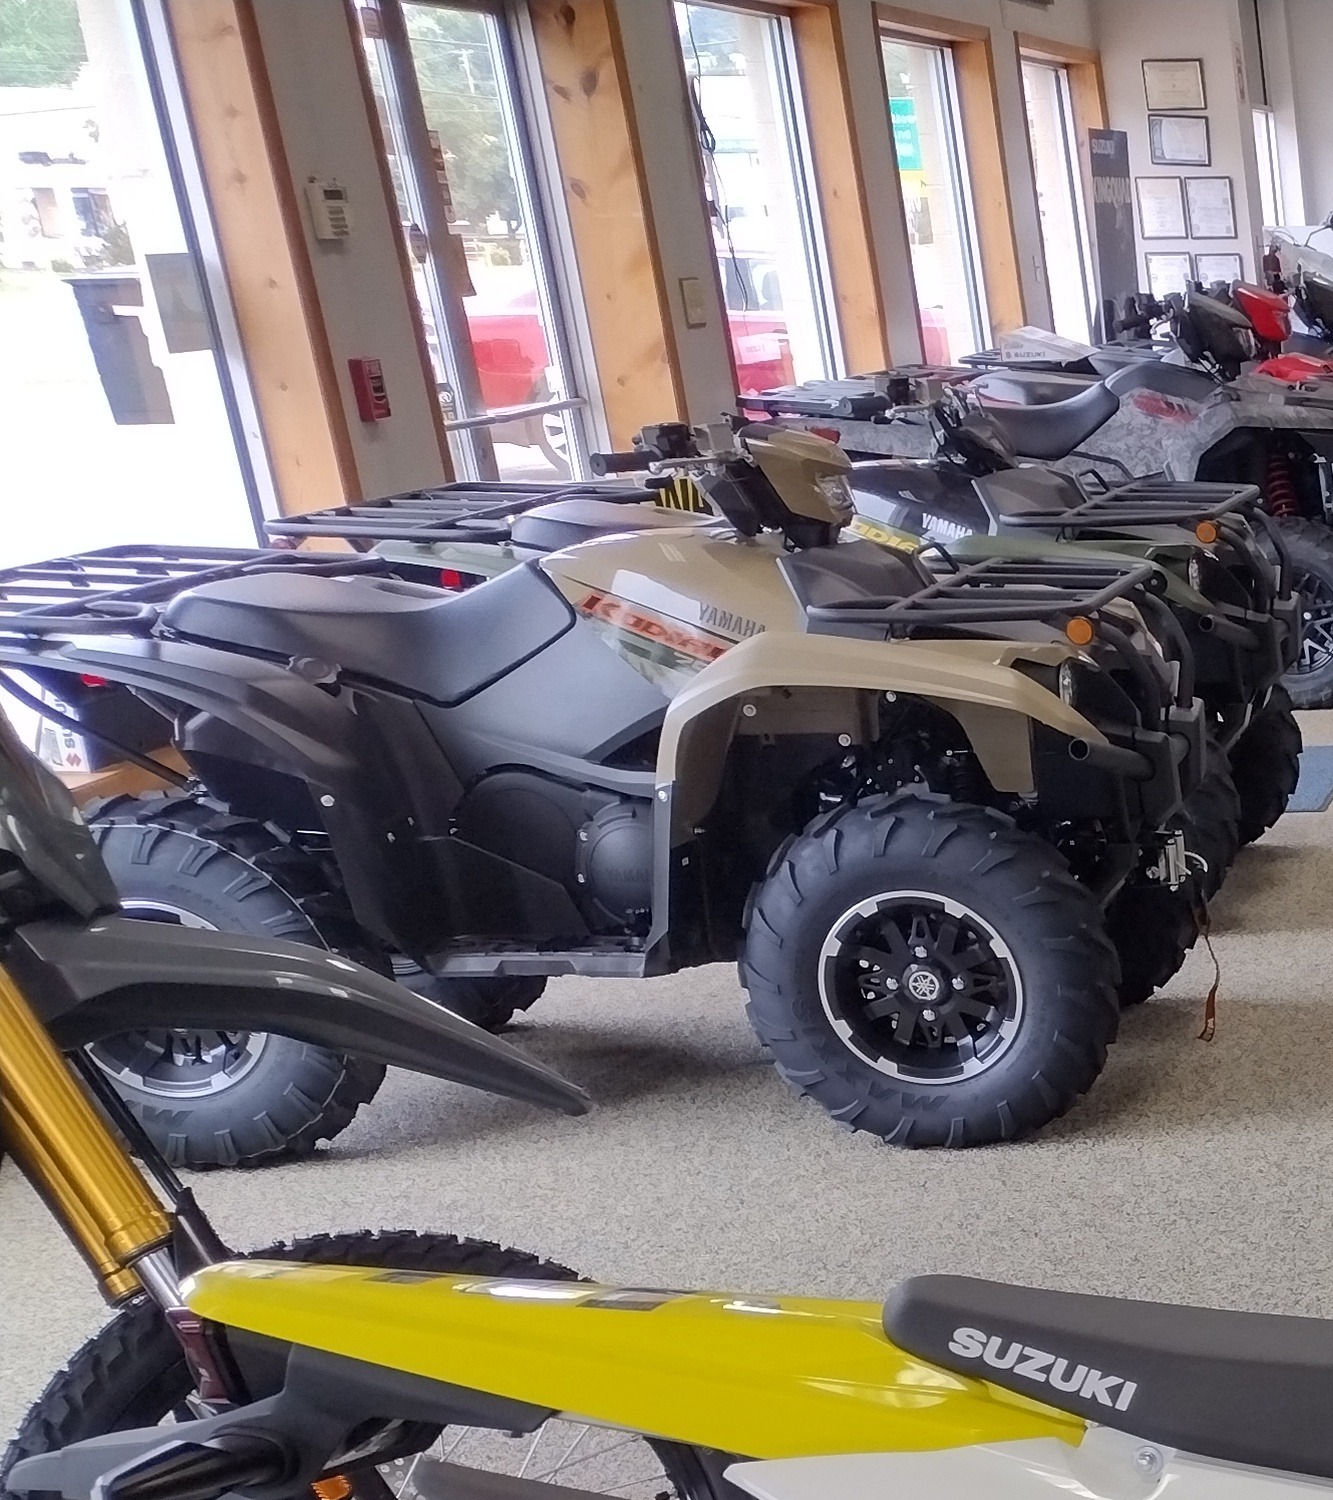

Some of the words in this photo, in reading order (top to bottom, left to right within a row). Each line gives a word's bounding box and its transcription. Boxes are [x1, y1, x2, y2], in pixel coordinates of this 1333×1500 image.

[921, 512, 973, 540] YAMAHA
[699, 600, 767, 639] YAMAHA
[948, 1326, 1138, 1422] SUZUKI
